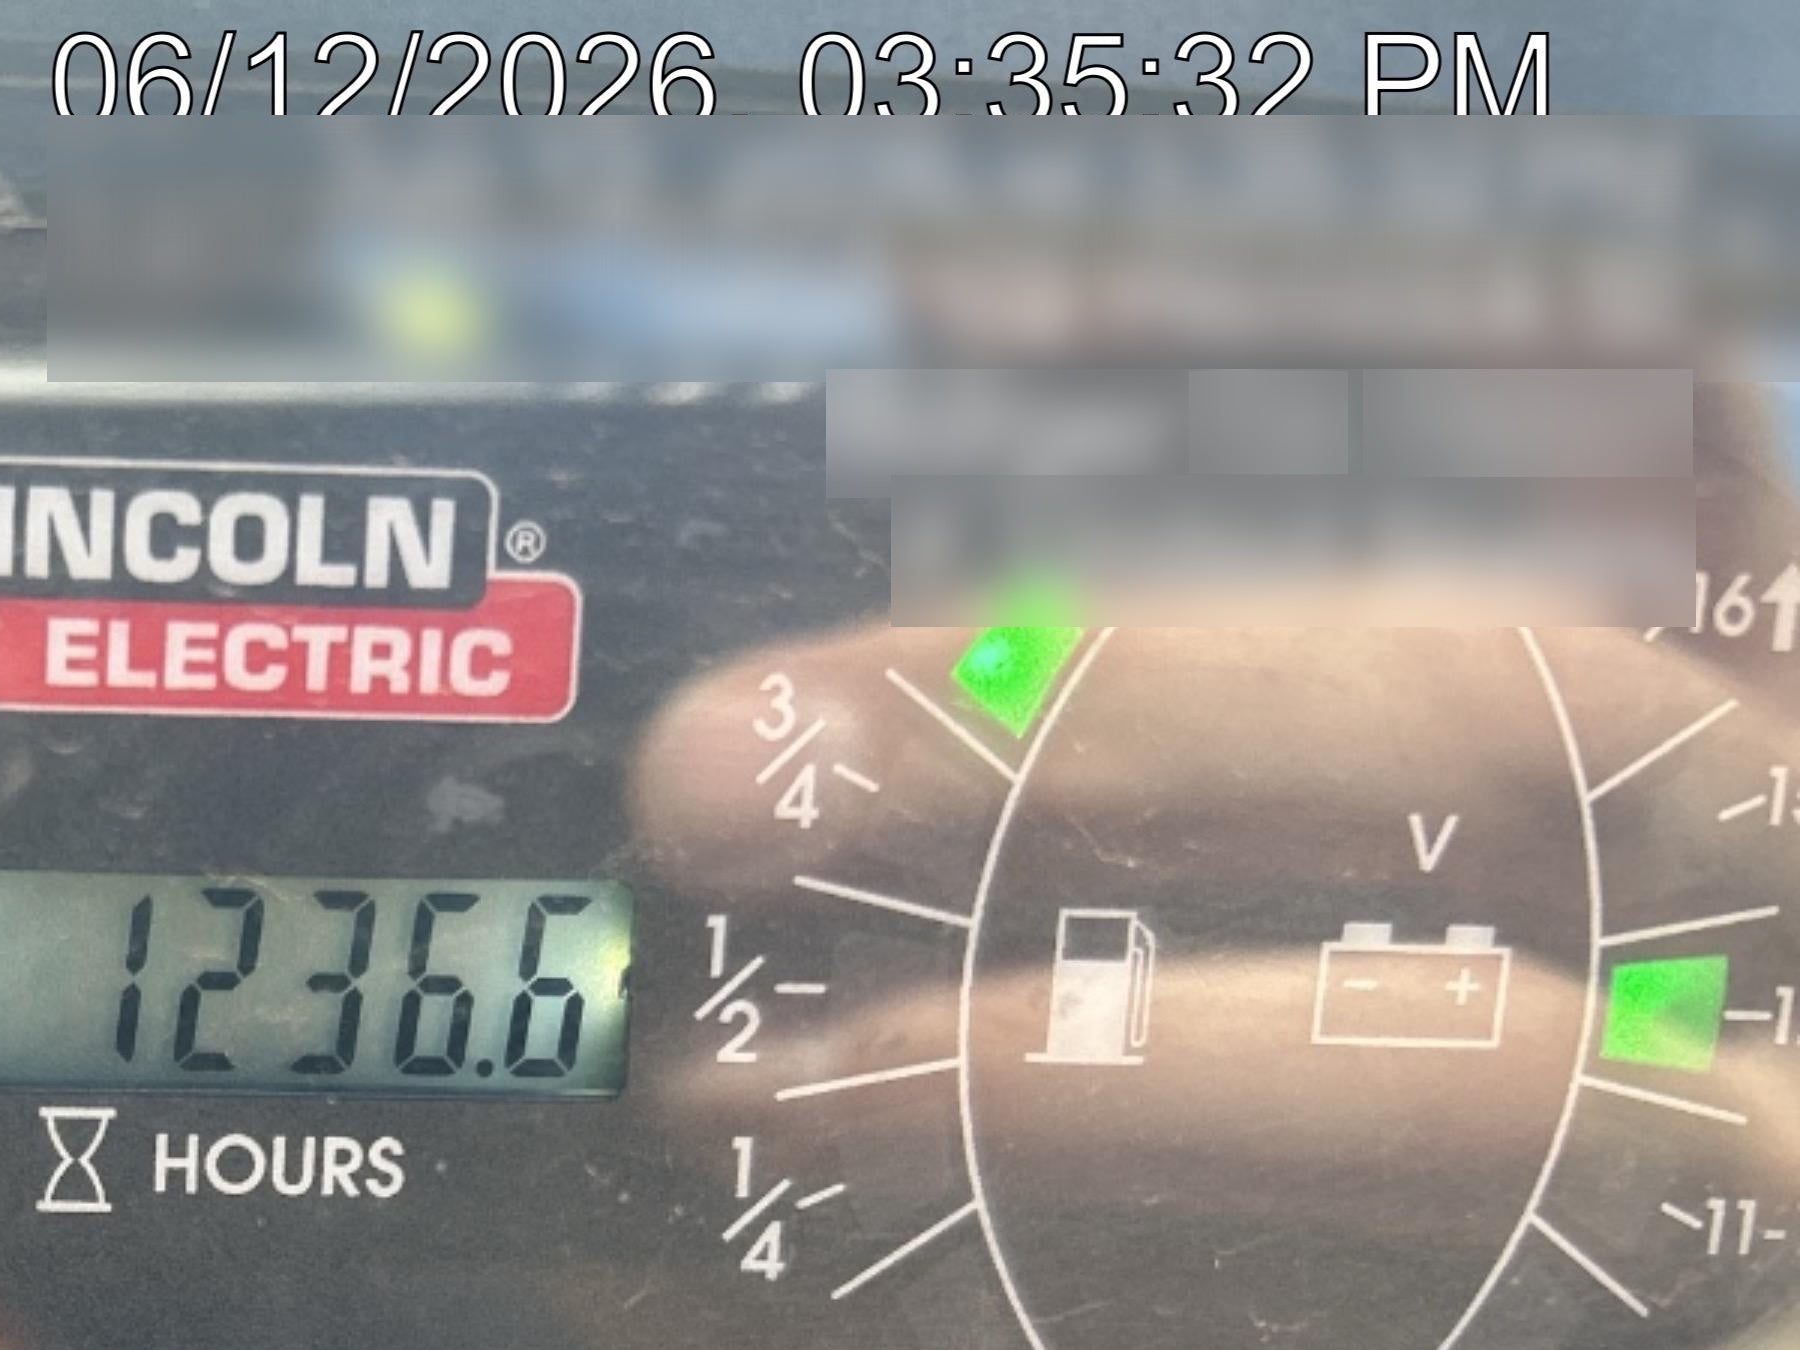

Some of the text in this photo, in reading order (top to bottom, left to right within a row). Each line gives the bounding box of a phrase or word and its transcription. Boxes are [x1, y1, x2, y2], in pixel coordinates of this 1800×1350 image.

[45, 617, 513, 697] ELECTRIC
[1407, 813, 1459, 872] V
[116, 888, 593, 1079] 1236.6
[154, 1133, 406, 1199] HOURS
